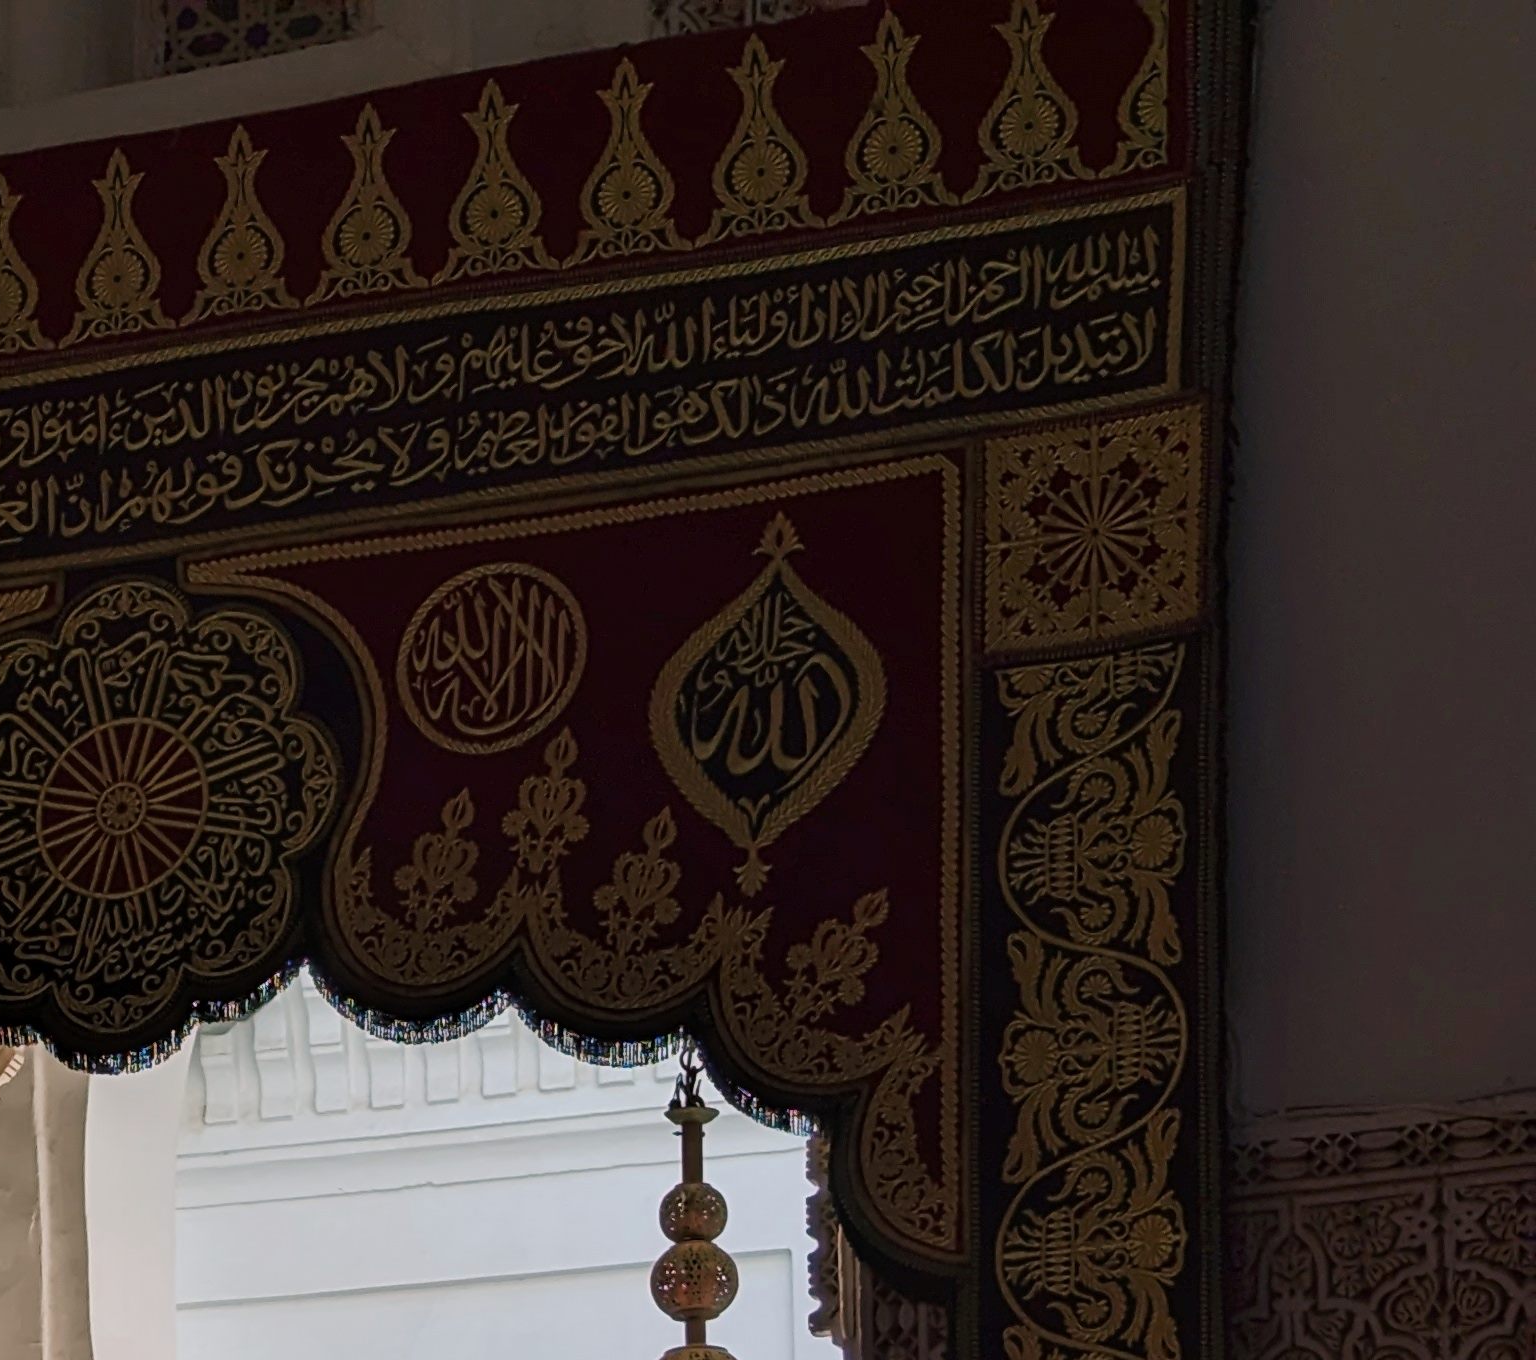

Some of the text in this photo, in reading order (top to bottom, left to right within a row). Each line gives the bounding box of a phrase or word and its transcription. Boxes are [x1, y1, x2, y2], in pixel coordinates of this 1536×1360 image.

[1046, 229, 1130, 283] الله
[1050, 225, 1161, 310] بسم
[628, 296, 714, 374] الله
[860, 256, 972, 342] الرحيم
[457, 323, 562, 401] عليهم
[540, 316, 625, 390] خوف
[595, 308, 648, 380] لا
[1015, 322, 1129, 392] تبديل
[1115, 307, 1156, 376] لا
[123, 376, 225, 450] الذين
[624, 388, 709, 457] هو
[790, 350, 890, 428] الله
[455, 402, 573, 474] العظيم
[95, 454, 243, 533] قولهم
[692, 653, 851, 794] الله
